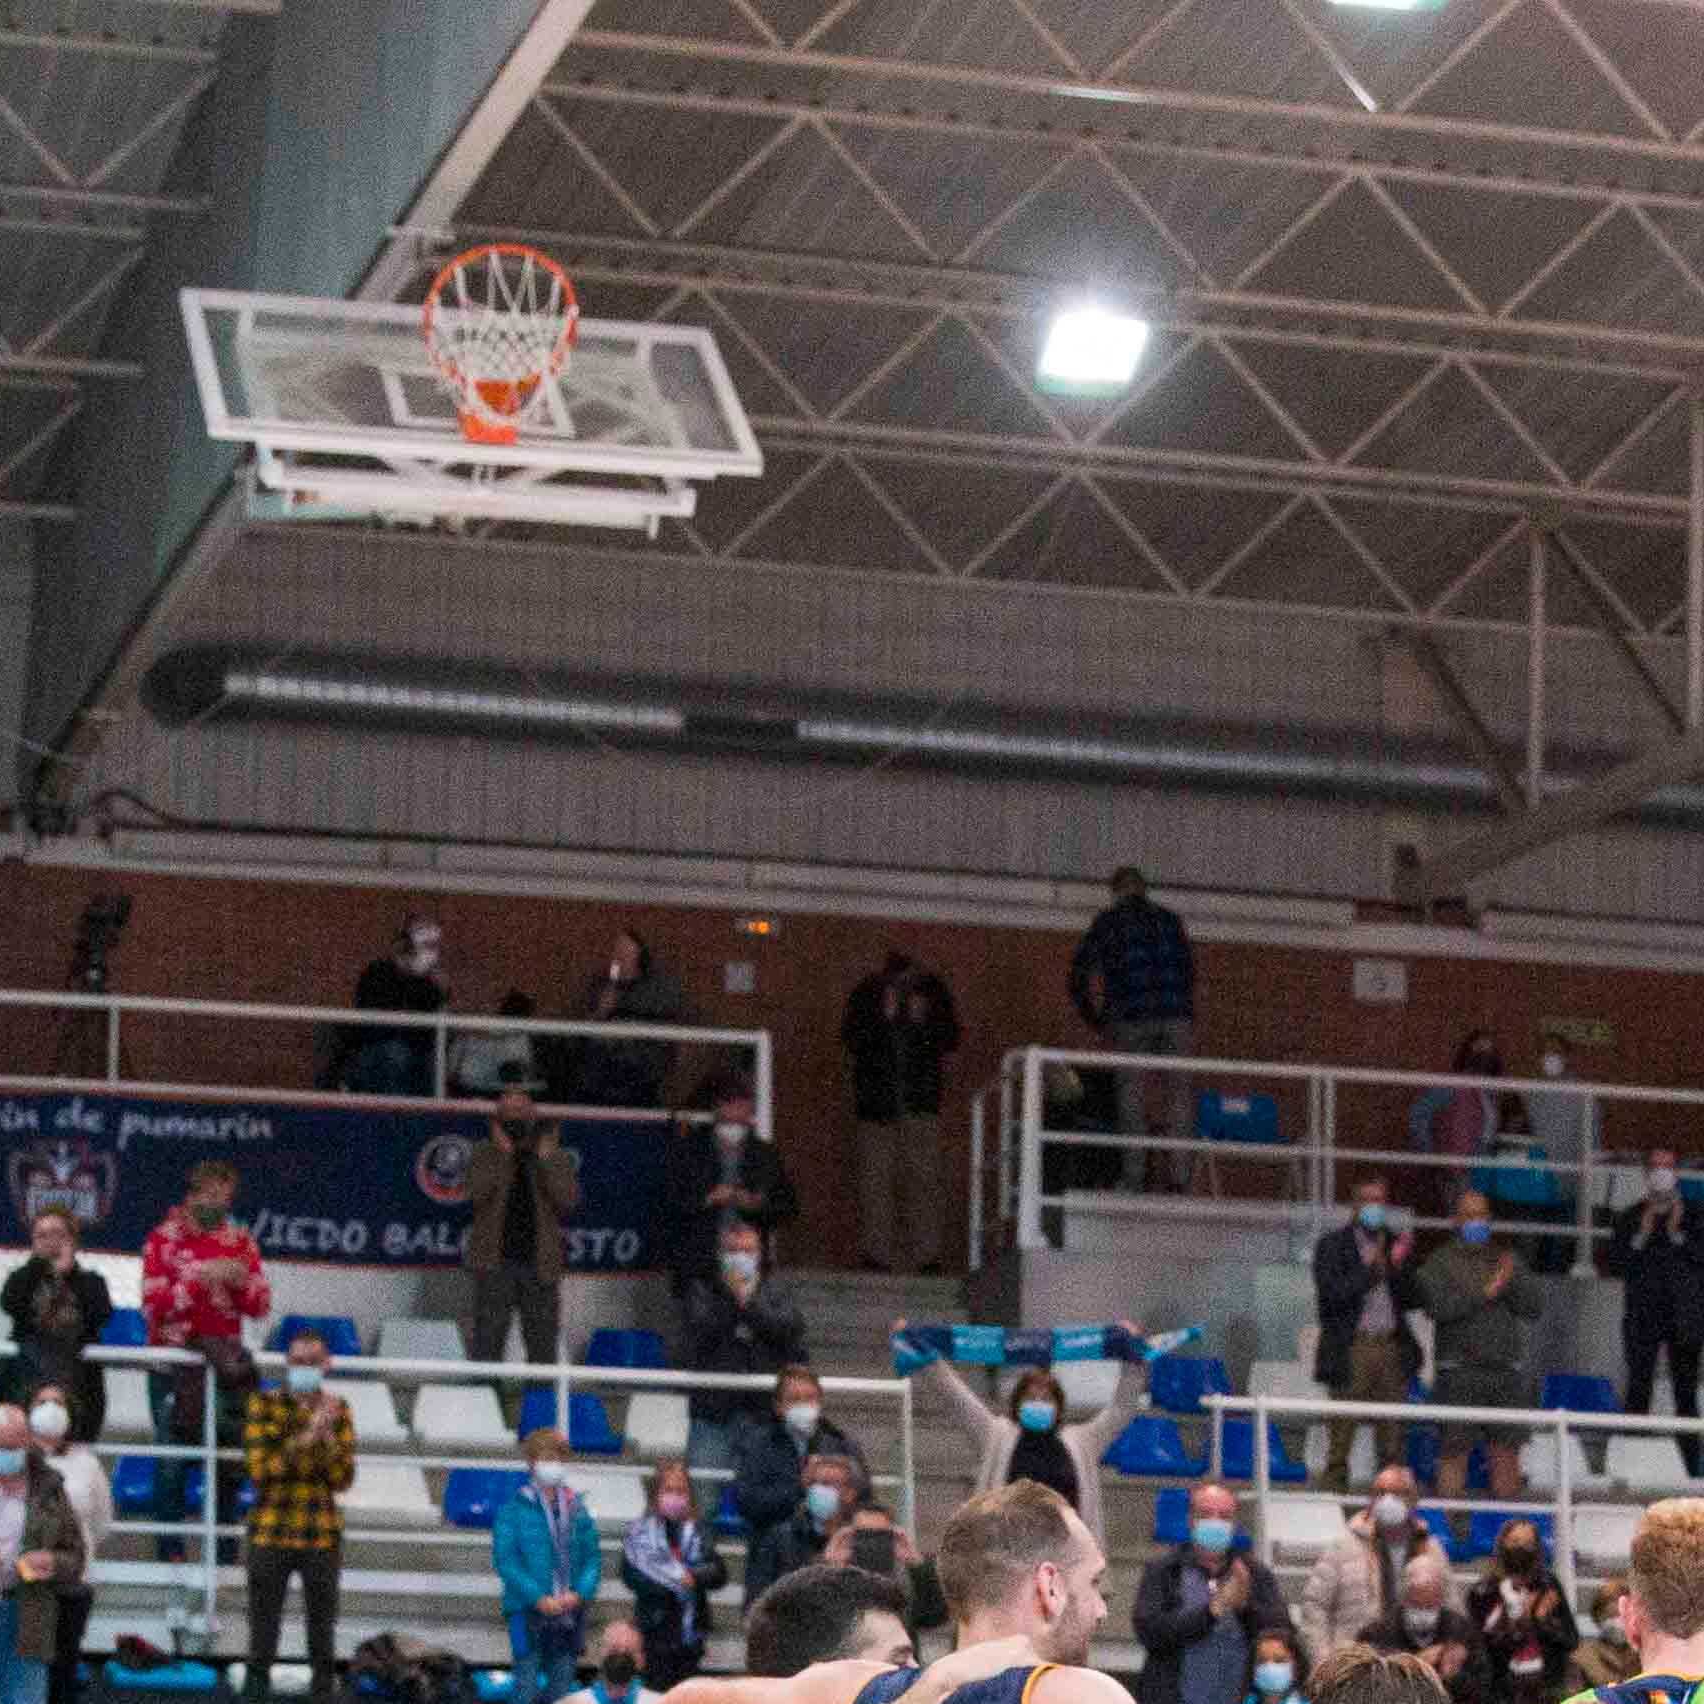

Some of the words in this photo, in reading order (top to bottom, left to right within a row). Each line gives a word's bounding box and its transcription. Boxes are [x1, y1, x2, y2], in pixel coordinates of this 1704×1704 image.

[53, 1098, 103, 1132] de
[252, 1207, 370, 1253] IEDO
[378, 1221, 641, 1262] BALSTO
